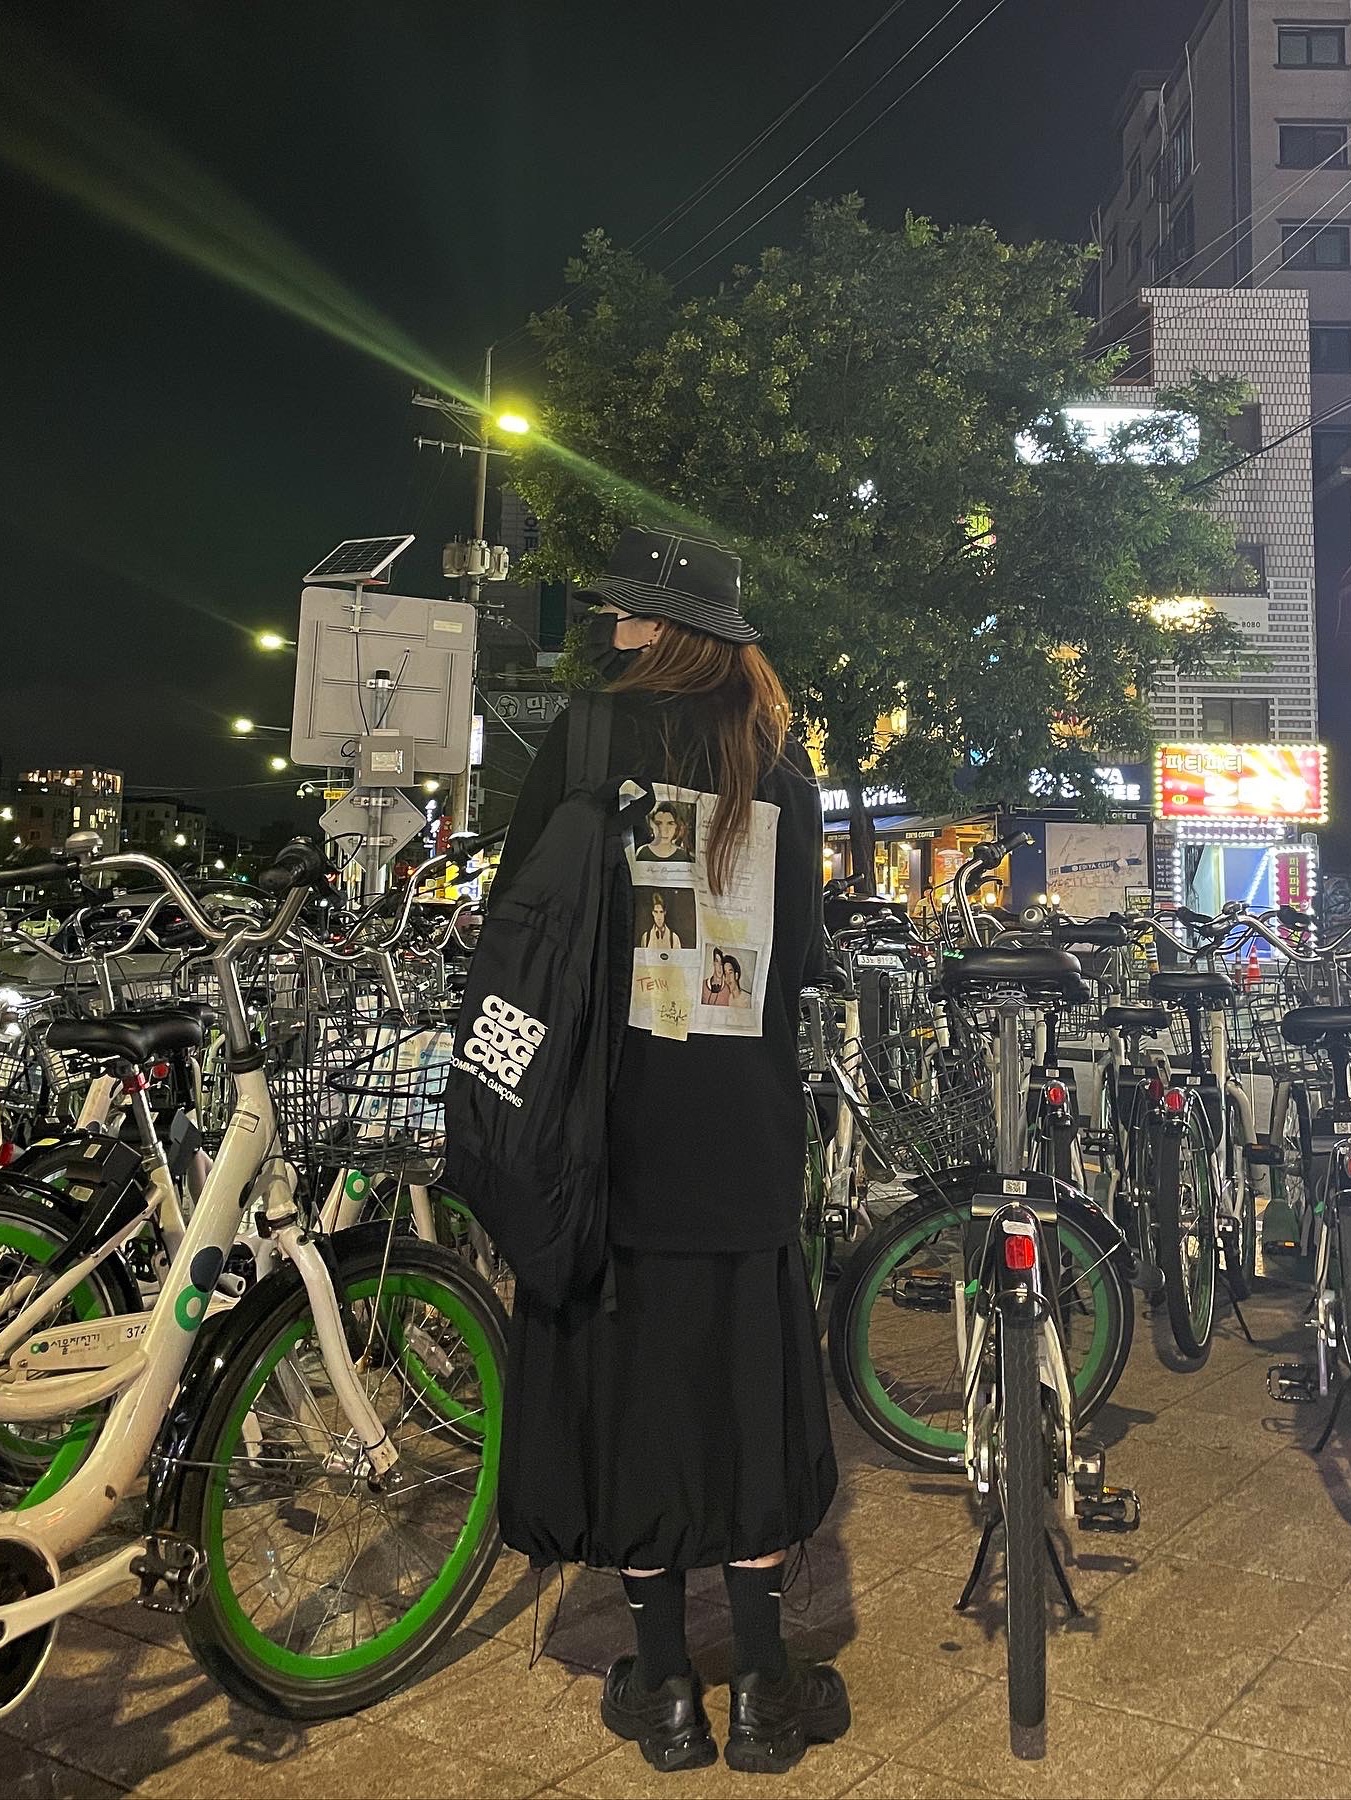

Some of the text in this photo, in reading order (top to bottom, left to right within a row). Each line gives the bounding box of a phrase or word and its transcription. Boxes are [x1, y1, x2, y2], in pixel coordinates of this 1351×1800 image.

[1165, 753, 1242, 773] 파티파티
[820, 788, 850, 812] DIYA
[473, 1015, 538, 1068] CDG
[482, 994, 548, 1047] CDG
[464, 1037, 527, 1089] CDG
[478, 1071, 487, 1084] des
[487, 1078, 524, 1108] GARÇONS
